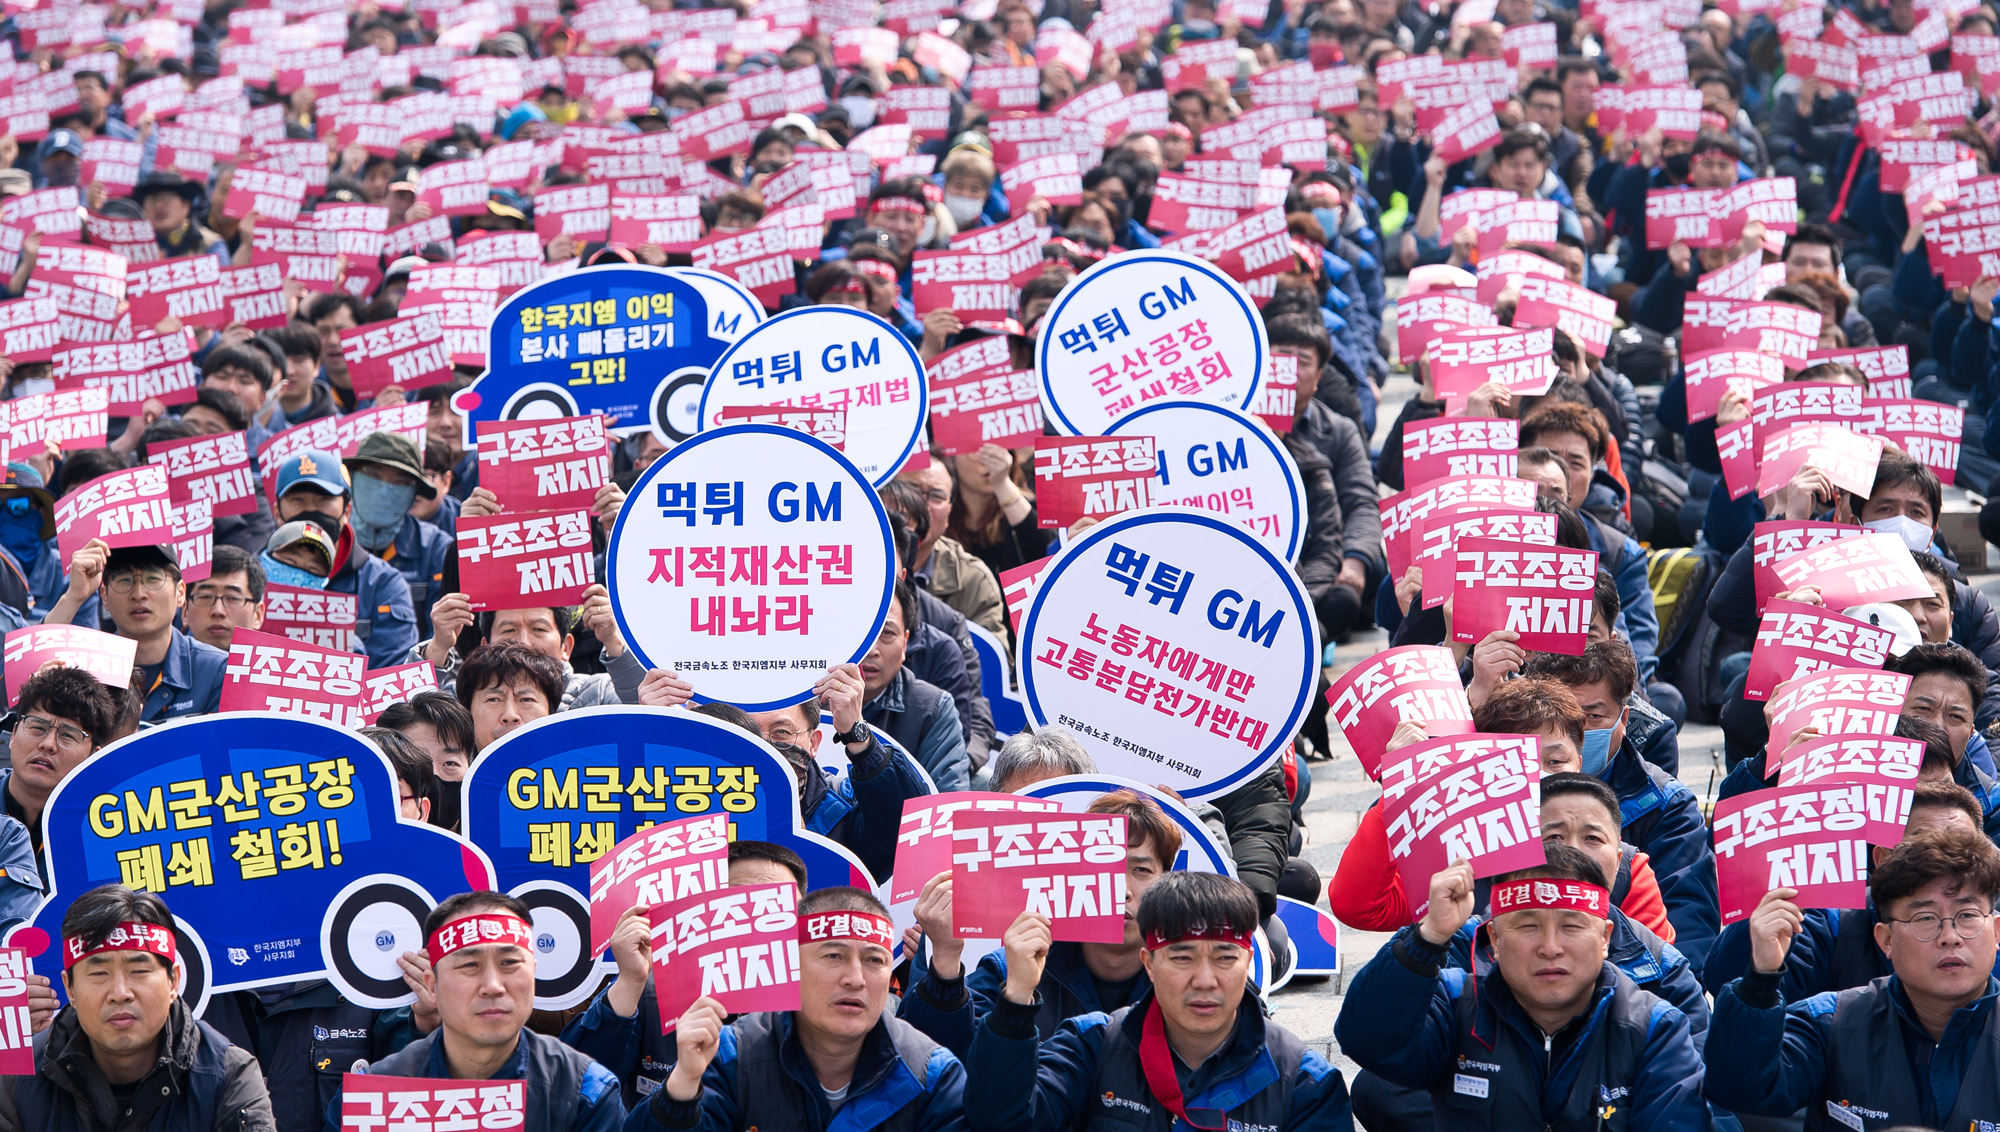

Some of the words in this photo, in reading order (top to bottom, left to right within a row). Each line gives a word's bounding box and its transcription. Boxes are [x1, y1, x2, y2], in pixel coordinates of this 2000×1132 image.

[127, 258, 220, 298] 구조조정
[912, 254, 1010, 285] 구조조정
[166, 285, 224, 319] 저지!
[520, 298, 616, 334] 한국지엠
[627, 292, 674, 322] 이익
[1059, 307, 1130, 356] 먹튀
[1139, 276, 1197, 320] GM
[341, 312, 442, 363] 구조조정
[520, 336, 568, 364] 본사
[577, 322, 675, 356] 빼돌리기
[714, 311, 743, 336] M
[52, 347, 144, 380] 구조조정
[388, 341, 450, 383] 저지!
[733, 351, 802, 389] 먹튀
[822, 337, 880, 373] GM
[1089, 318, 1213, 396] 군산공장
[1440, 327, 1553, 367] 구조조정
[568, 357, 627, 387] 그만!
[930, 369, 1038, 417] 구조조정
[978, 402, 1044, 441] 저지!
[1753, 386, 1863, 426] 구조조정
[1862, 404, 1963, 438] 구조조정
[477, 416, 605, 466] 구조조정
[1035, 437, 1155, 482] 구조조정
[1187, 437, 1248, 477] GM
[1403, 420, 1518, 461] 구조조정
[1905, 437, 1959, 471] 저지!
[188, 462, 255, 500] 저지!
[534, 456, 609, 497] 저지!
[1083, 477, 1155, 515] 저지!
[54, 465, 168, 534] 구조조정
[98, 499, 173, 537] 저지!
[656, 481, 744, 526] 먹튀
[767, 481, 841, 523] GM
[1411, 478, 1535, 521] 구조조정
[457, 510, 592, 563] 구조조정
[516, 551, 595, 595] 저지!
[647, 544, 852, 587] 지적재산권
[1456, 551, 1595, 590] 구조조정
[266, 591, 357, 625] 조조정
[690, 595, 814, 637] 내놔라
[1105, 541, 1195, 616] 먹튀
[1207, 589, 1286, 649] GM
[1505, 596, 1592, 635] 저지!
[1079, 612, 1256, 704] 노동자에게만
[1757, 612, 1894, 666] 구조조정
[226, 643, 362, 695] 구조조정
[673, 660, 729, 671] 전국금속노조
[732, 660, 787, 671] 한국지엠지부
[791, 659, 827, 670] 사무지회
[1036, 636, 1270, 752] 고통분담전가반대
[1331, 649, 1460, 731] 구조조정
[1390, 688, 1472, 723] 저지!
[1771, 673, 1909, 726] 구조조정
[1808, 706, 1900, 735] 저지!
[1057, 713, 1111, 743] 전국금속노조
[1113, 735, 1165, 764] 한국지엠지부
[1166, 757, 1202, 780] 사무지회
[1779, 740, 1925, 786] 구조조정
[88, 757, 356, 839] GM군산공장
[506, 765, 760, 814] GM군산공장
[1387, 748, 1528, 858] 구조조정
[1866, 784, 1914, 826] 지!
[1440, 798, 1542, 866] 저지!
[1713, 784, 1867, 858] 구조조정
[115, 835, 214, 894] 폐쇄
[229, 818, 344, 881] 철회!
[528, 820, 618, 868] 폐쇄
[590, 814, 728, 903] 구조조정
[953, 817, 1127, 872] 구조조정
[1766, 838, 1867, 892] 저지!
[634, 858, 729, 908] 저지!
[1022, 872, 1127, 920] 저지!
[1498, 883, 1531, 908] 단결
[1562, 884, 1599, 910] 투쟁
[129, 924, 170, 953] 투쟁
[253, 938, 302, 953] 한국지엠지부
[375, 934, 396, 947] GM
[438, 918, 480, 954] 단결
[537, 938, 555, 948] GM
[652, 884, 797, 966] 구조조정
[808, 914, 851, 940] 단결
[263, 950, 295, 962] 사무지회
[698, 939, 801, 998] 저지!
[330, 1028, 367, 1039] 금속노조
[342, 1082, 525, 1132] 구조조정
